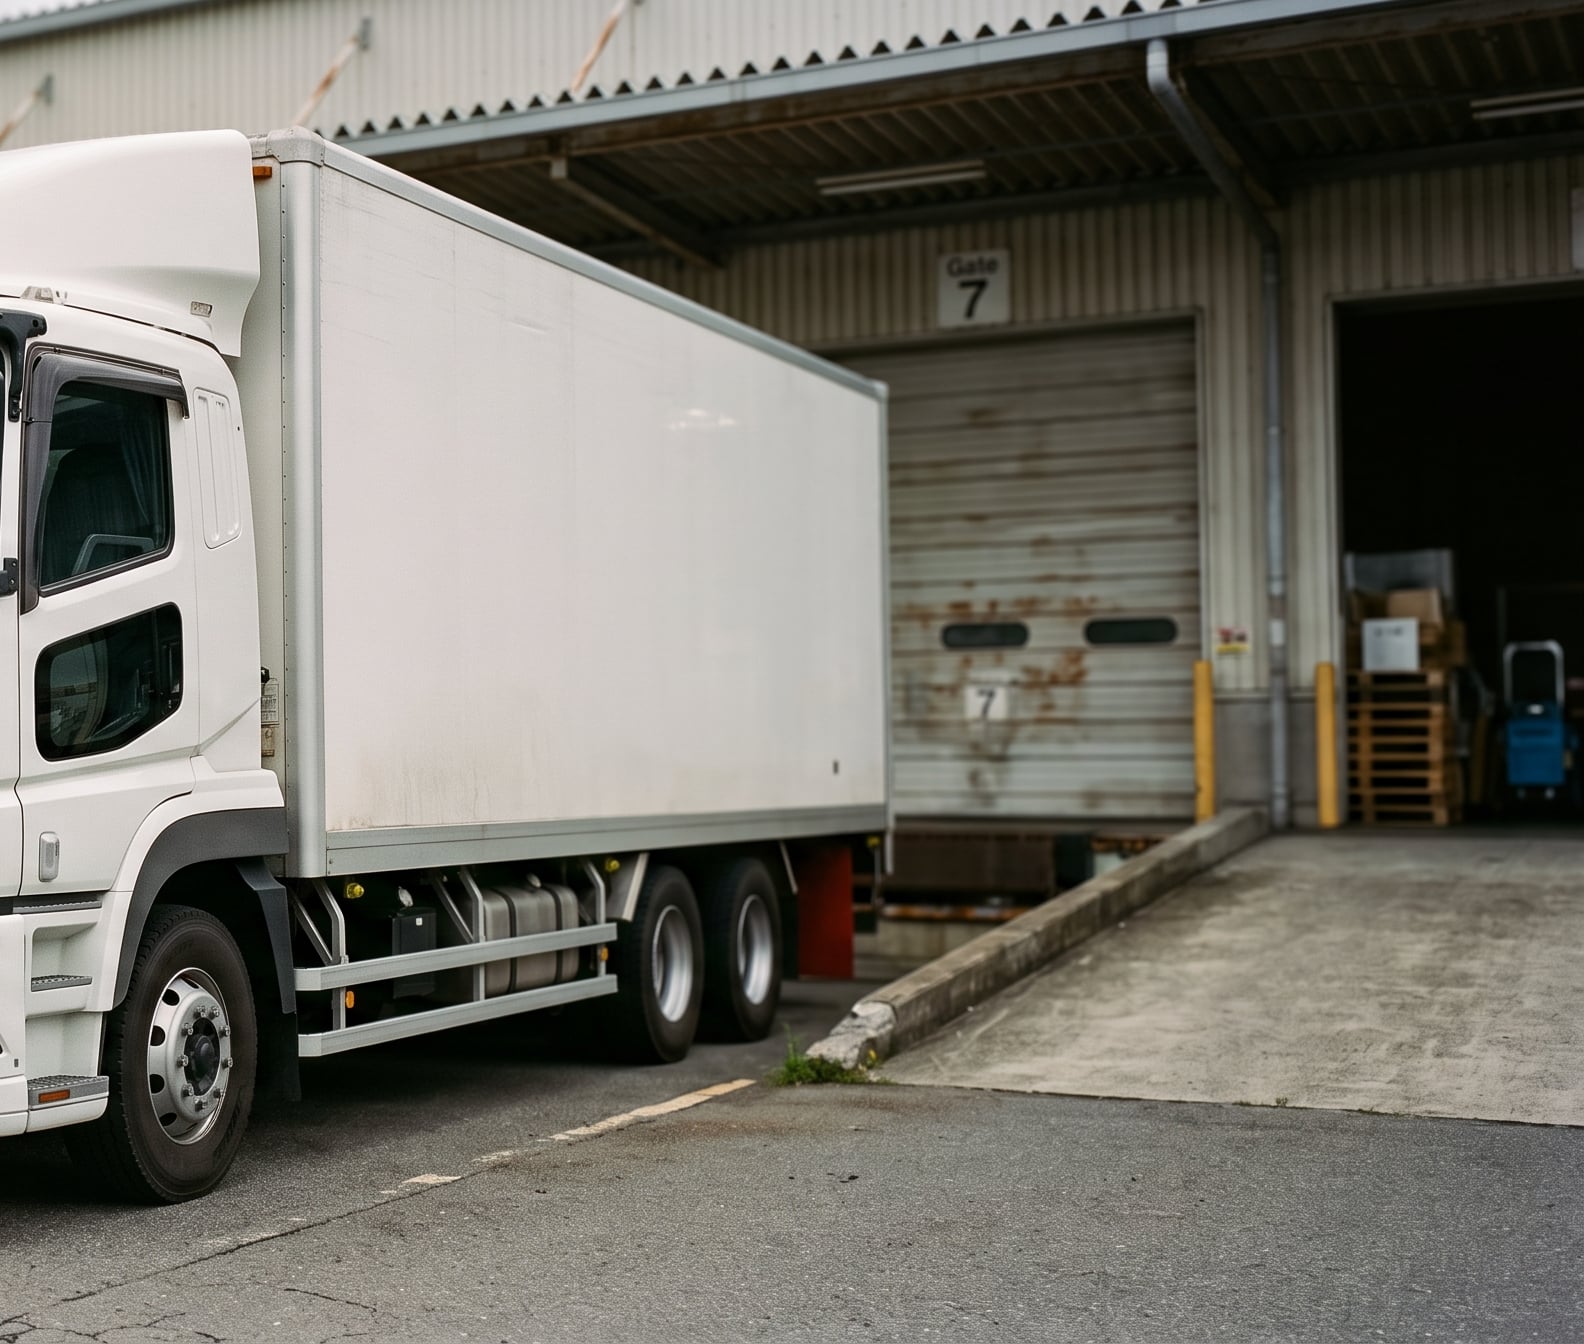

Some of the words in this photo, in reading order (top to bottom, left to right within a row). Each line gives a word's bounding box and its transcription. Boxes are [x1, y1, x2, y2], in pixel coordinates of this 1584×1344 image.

[946, 256, 999, 278] Gate
[958, 279, 988, 319] 7
[976, 689, 996, 719] 7
